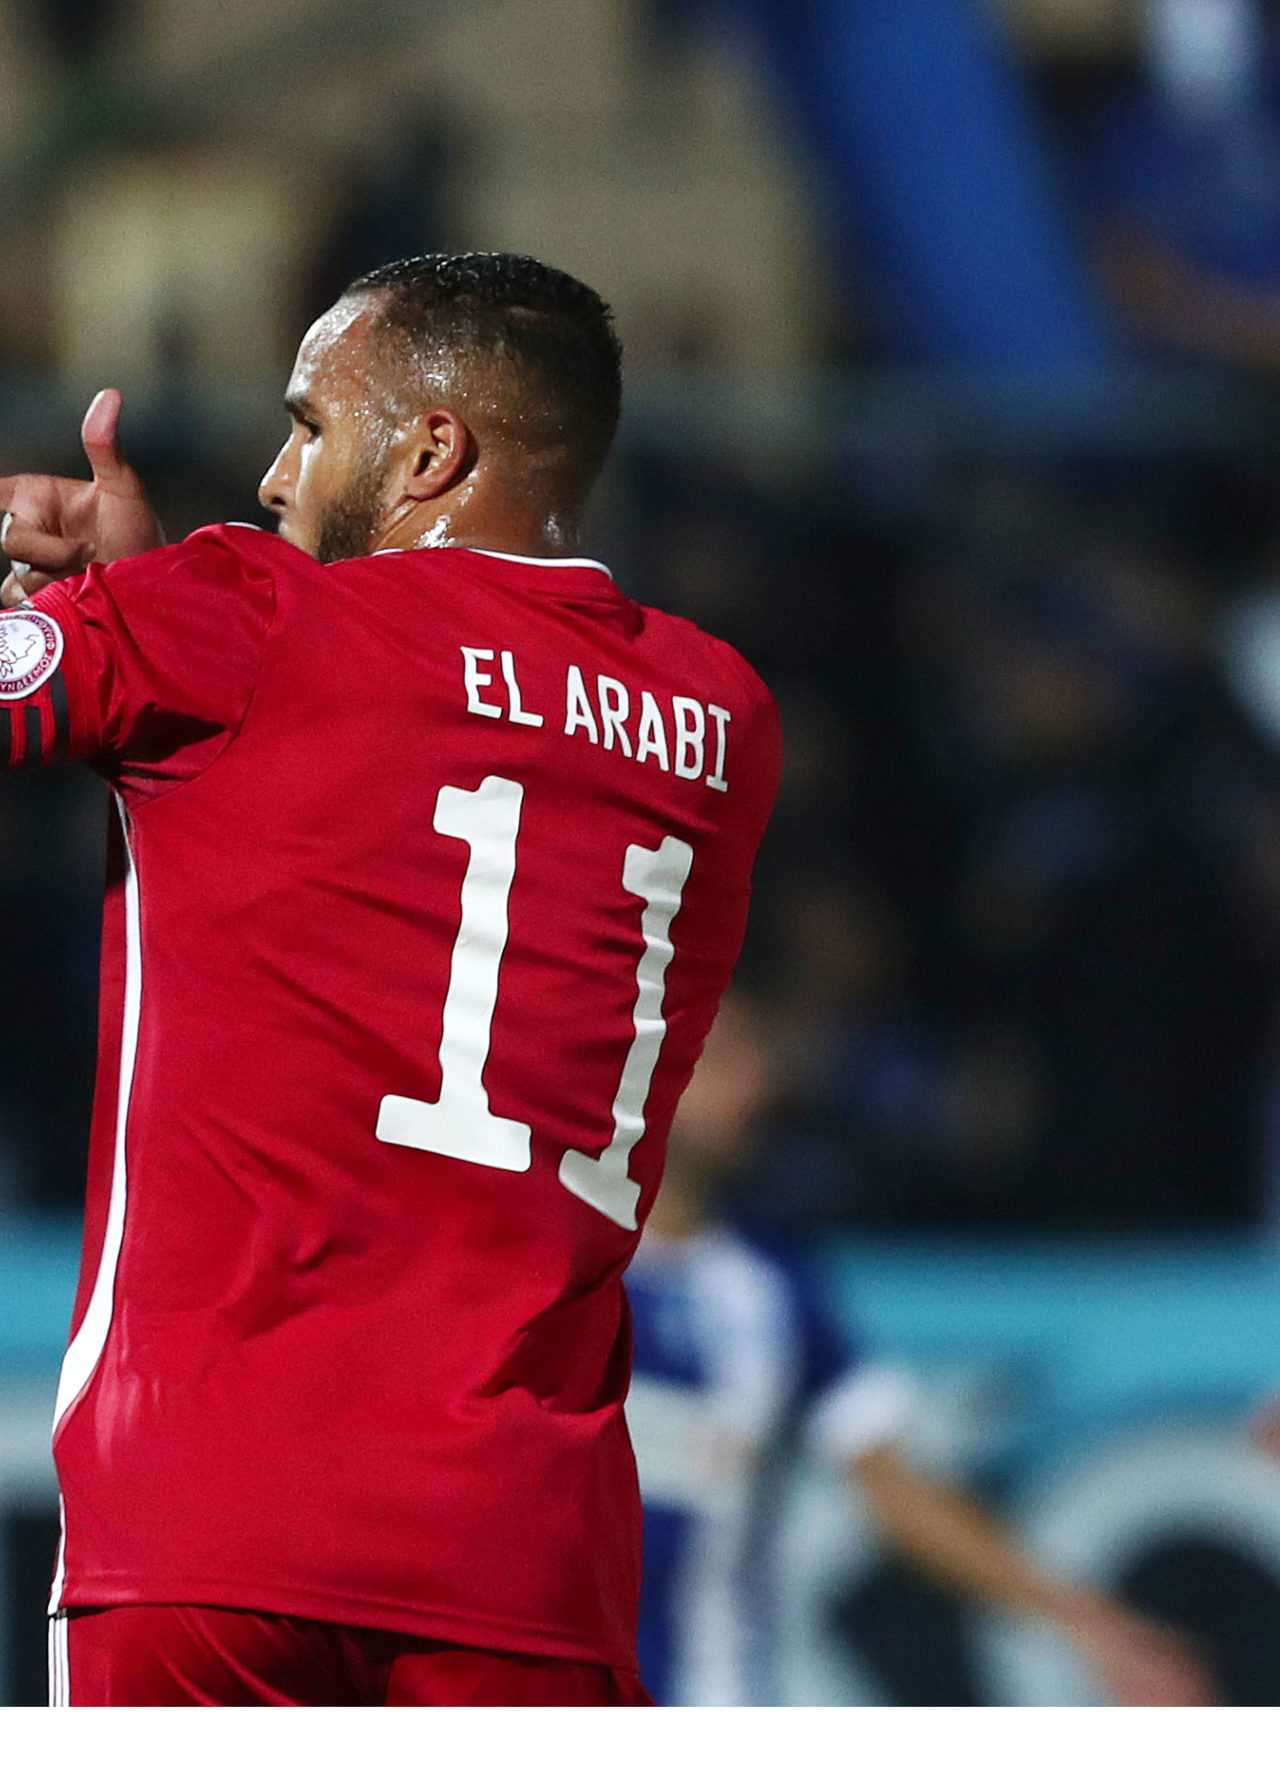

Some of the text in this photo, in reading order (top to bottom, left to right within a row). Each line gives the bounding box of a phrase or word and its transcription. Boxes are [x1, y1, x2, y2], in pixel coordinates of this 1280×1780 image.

[460, 646, 731, 792] EL ARABI
[375, 774, 694, 1232] 11
